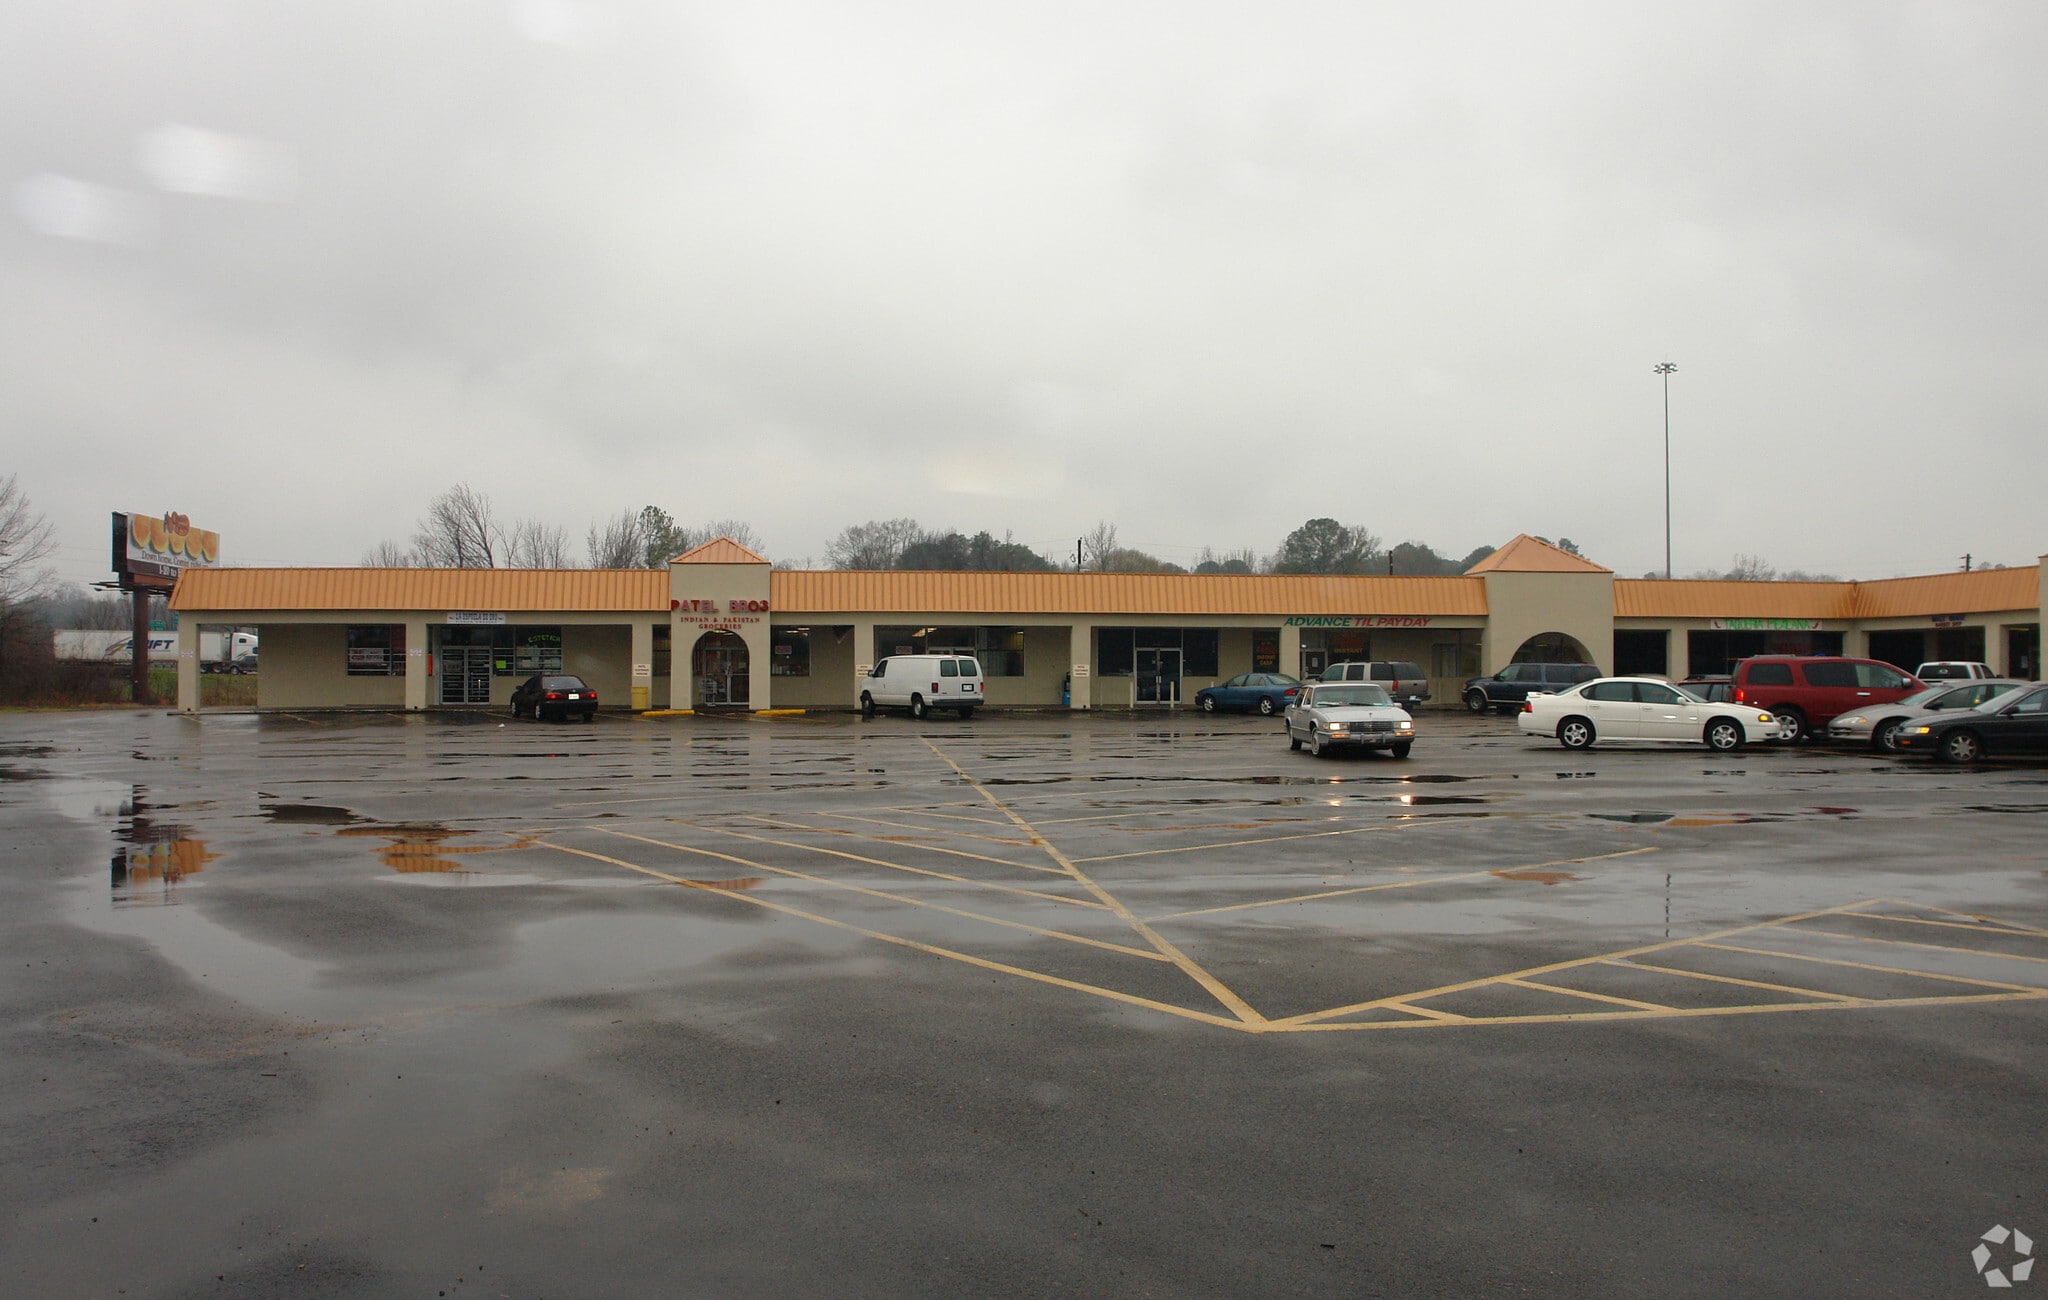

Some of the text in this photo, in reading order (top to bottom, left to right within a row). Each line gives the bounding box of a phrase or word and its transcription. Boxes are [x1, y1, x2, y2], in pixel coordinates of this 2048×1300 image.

[671, 600, 769, 613] PATEL BROS
[1284, 617, 1431, 627] ADVANCE TIL PAYDAY
[126, 640, 174, 649] SIFT
